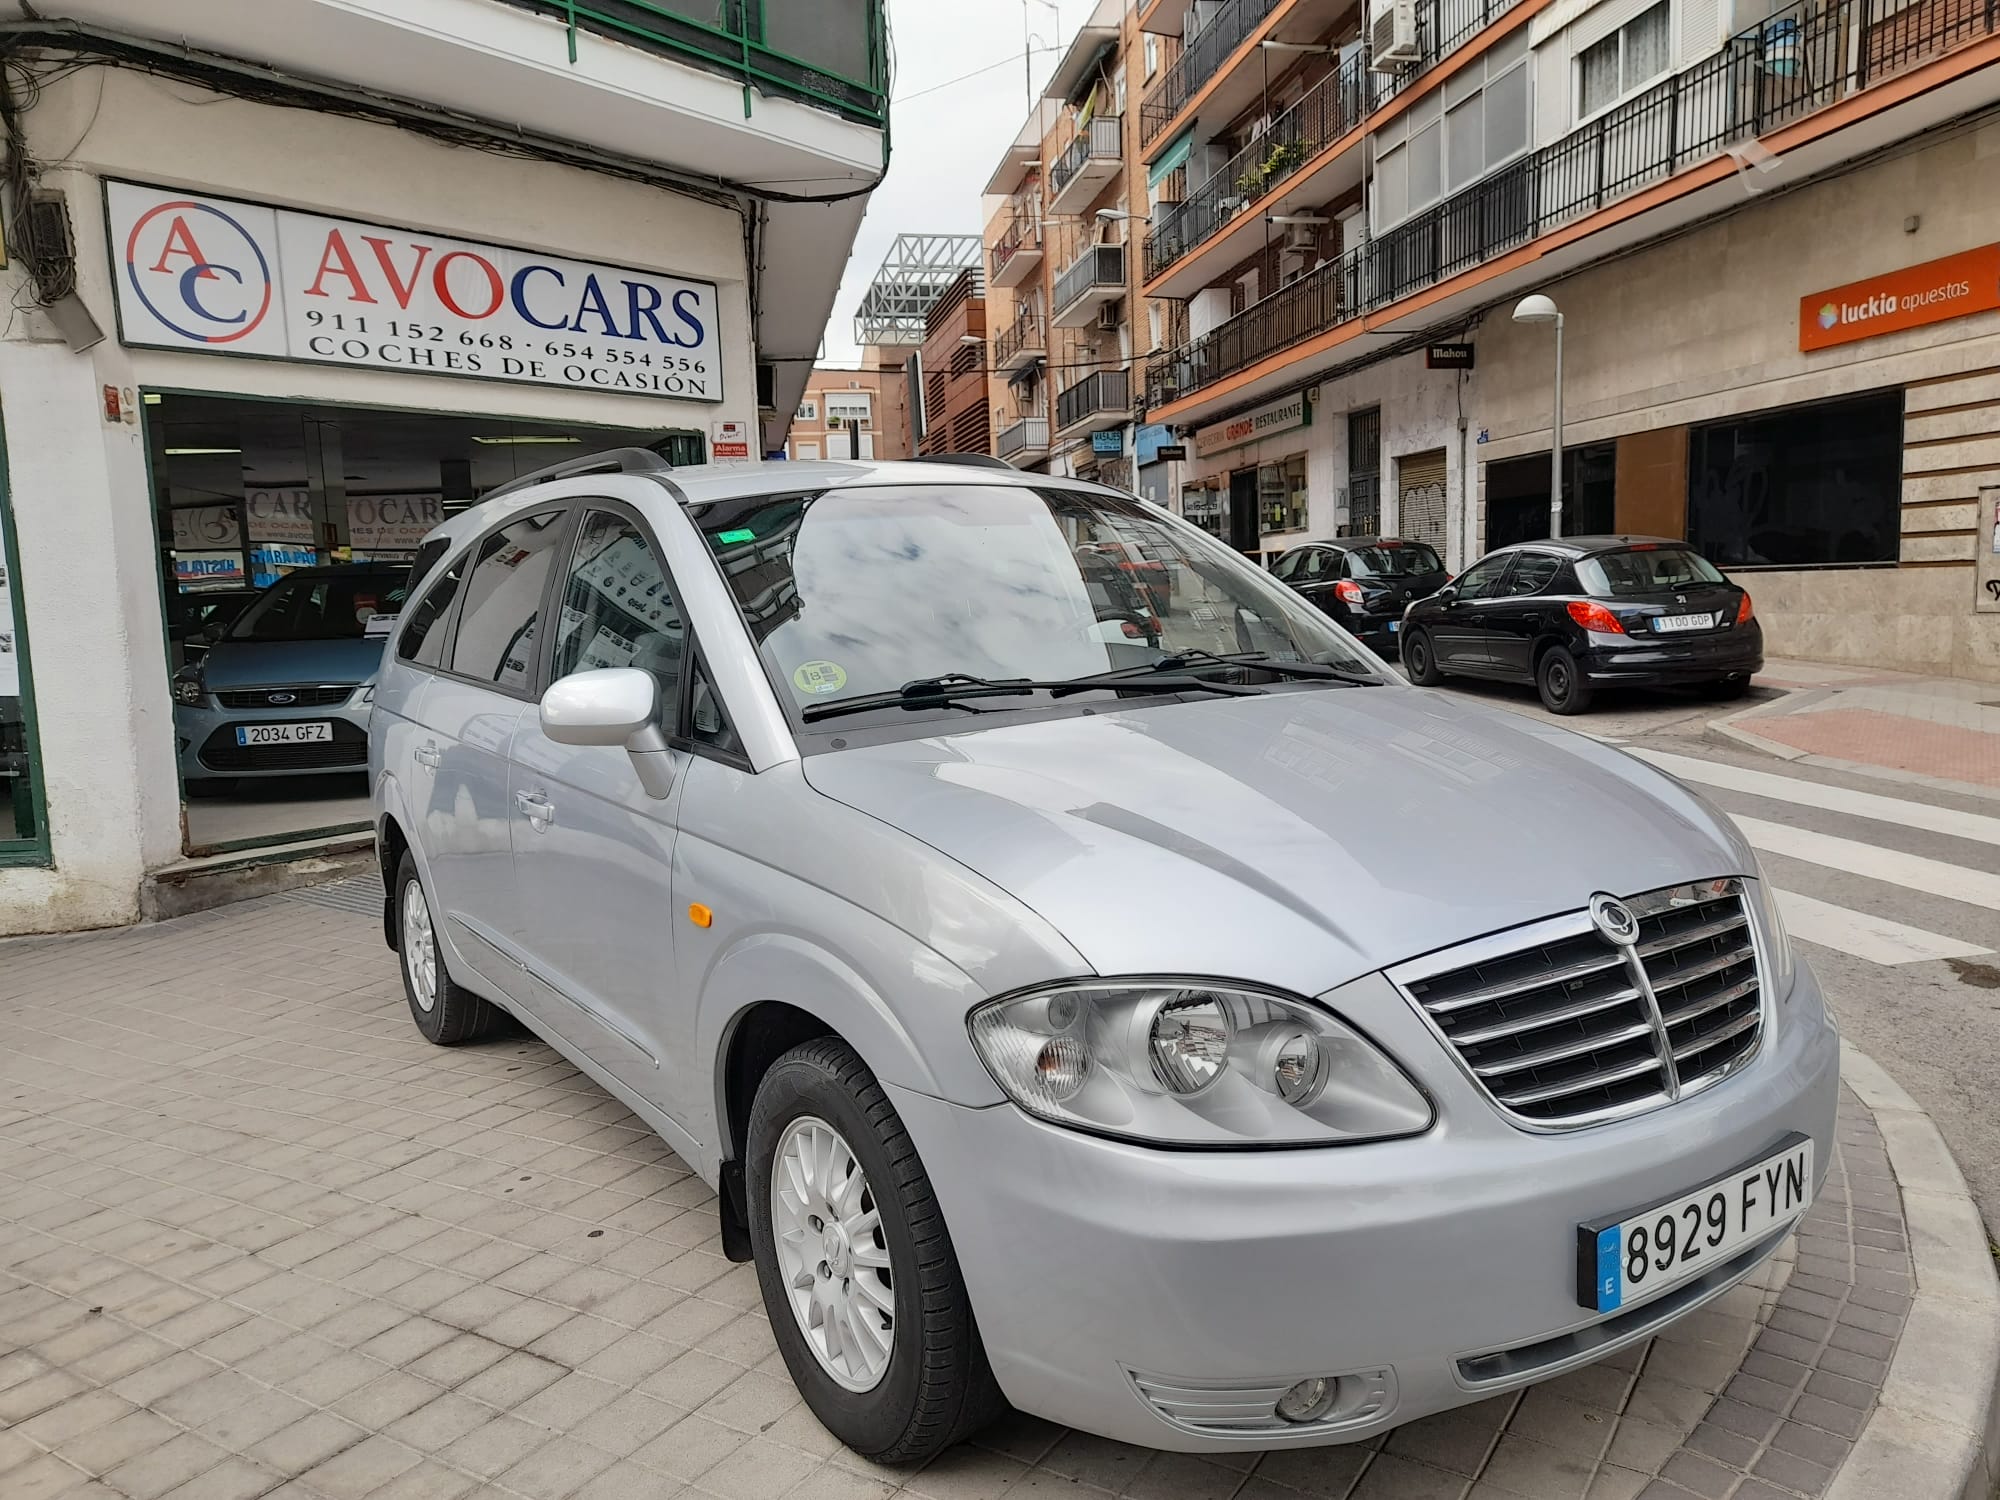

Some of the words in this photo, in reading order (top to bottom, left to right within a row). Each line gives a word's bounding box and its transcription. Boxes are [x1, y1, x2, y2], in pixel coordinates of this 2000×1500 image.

[304, 228, 705, 349] AVOCARS
[1841, 292, 1897, 324] luckia
[1901, 280, 1970, 312] apuestas
[306, 310, 369, 334] 911
[387, 321, 444, 342] 152
[459, 330, 513, 350] 668
[545, 341, 594, 360] 654
[606, 349, 652, 367] 554
[663, 356, 706, 374] 556
[1433, 348, 1467, 358] Mahou
[309, 336, 482, 372] COCHES
[501, 357, 547, 378] DE
[563, 364, 706, 395] OCASIÓN
[1226, 418, 1253, 441] GRANDE
[1255, 402, 1302, 429] RESTAURANTE
[715, 443, 746, 452] Alarma
[1662, 616, 1689, 629] 1100
[1691, 615, 1710, 626] GDP
[251, 727, 290, 743] 2034
[296, 725, 326, 741] GFZ
[1626, 1192, 1727, 1284] 8929
[1741, 1152, 1804, 1233] FYN
[1604, 1277, 1615, 1296] E
